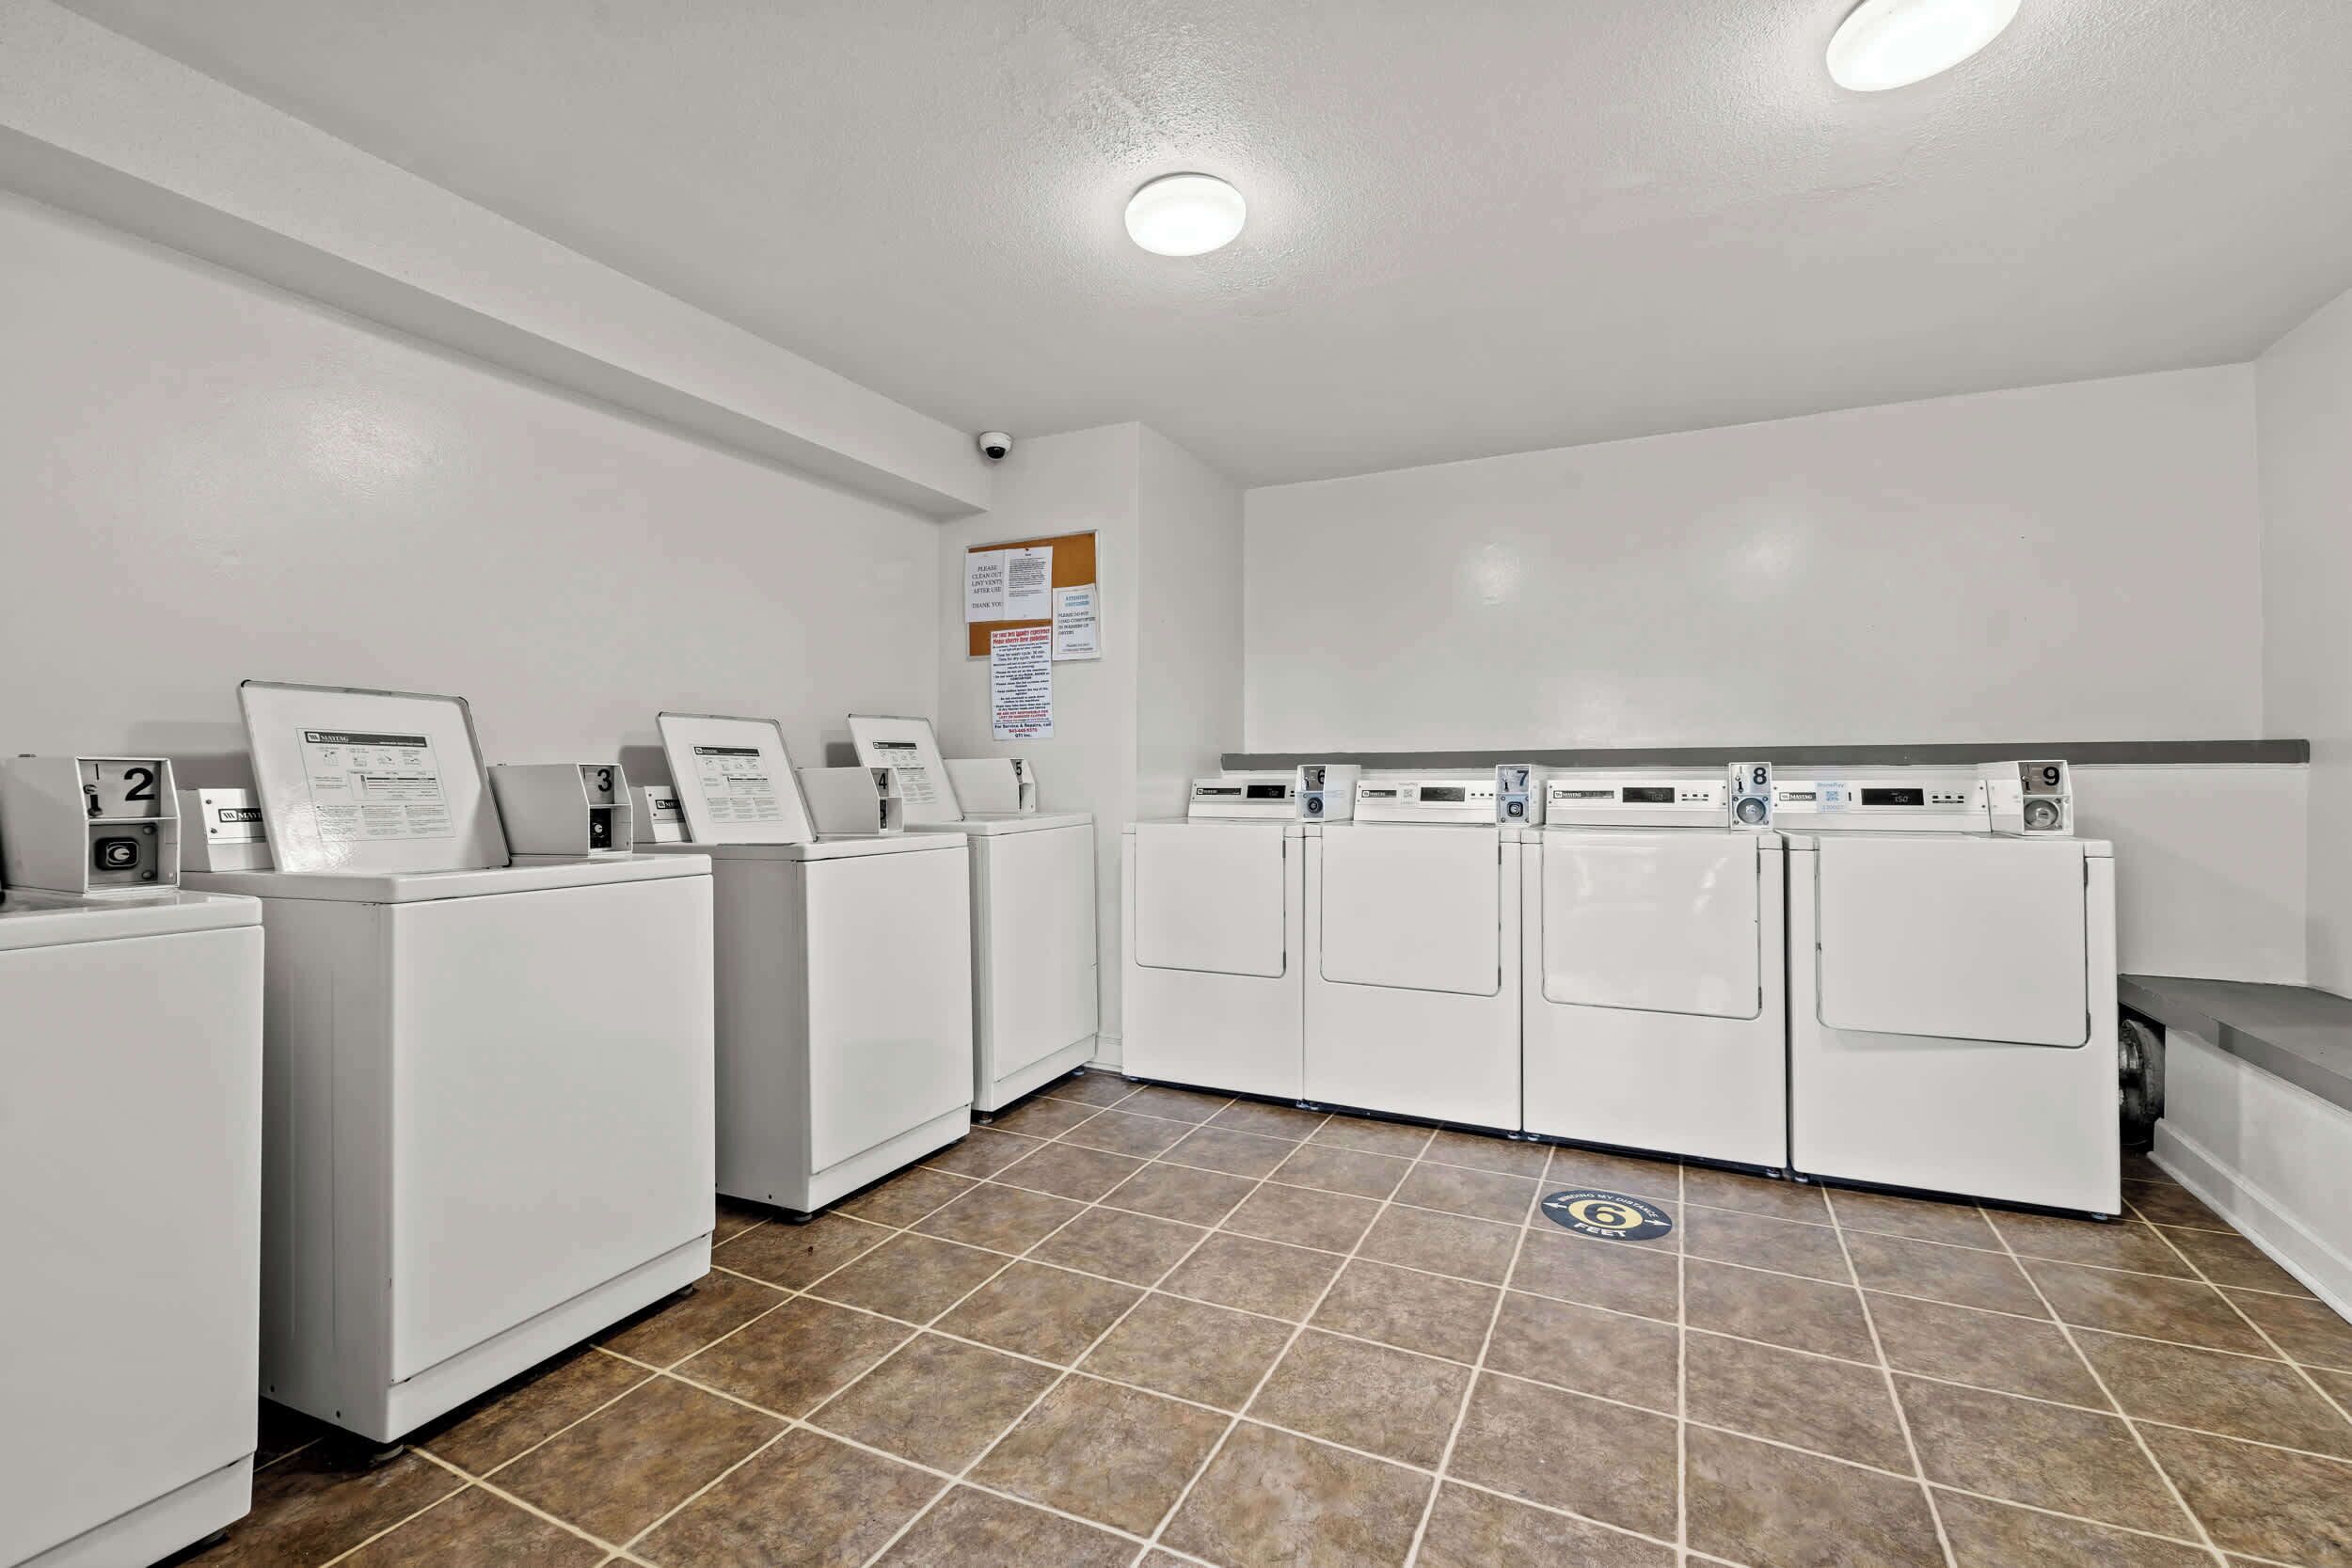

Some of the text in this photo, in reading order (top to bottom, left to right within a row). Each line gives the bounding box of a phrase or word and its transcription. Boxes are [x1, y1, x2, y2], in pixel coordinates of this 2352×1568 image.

[320, 735, 348, 743] MAYTAG
[1015, 761, 1023, 776] 5
[1317, 768, 1326, 784] 6
[1753, 767, 1767, 784] 8
[2042, 766, 2060, 786] 9
[123, 767, 155, 801] 2
[596, 768, 612, 792] 3
[878, 772, 888, 790] 4
[1517, 769, 1529, 786] 7
[237, 811, 262, 820] MAYT
[1583, 1203, 1627, 1226] 6
[1615, 1197, 1659, 1218] DISTANCE
[1573, 1222, 1627, 1238] FEET
